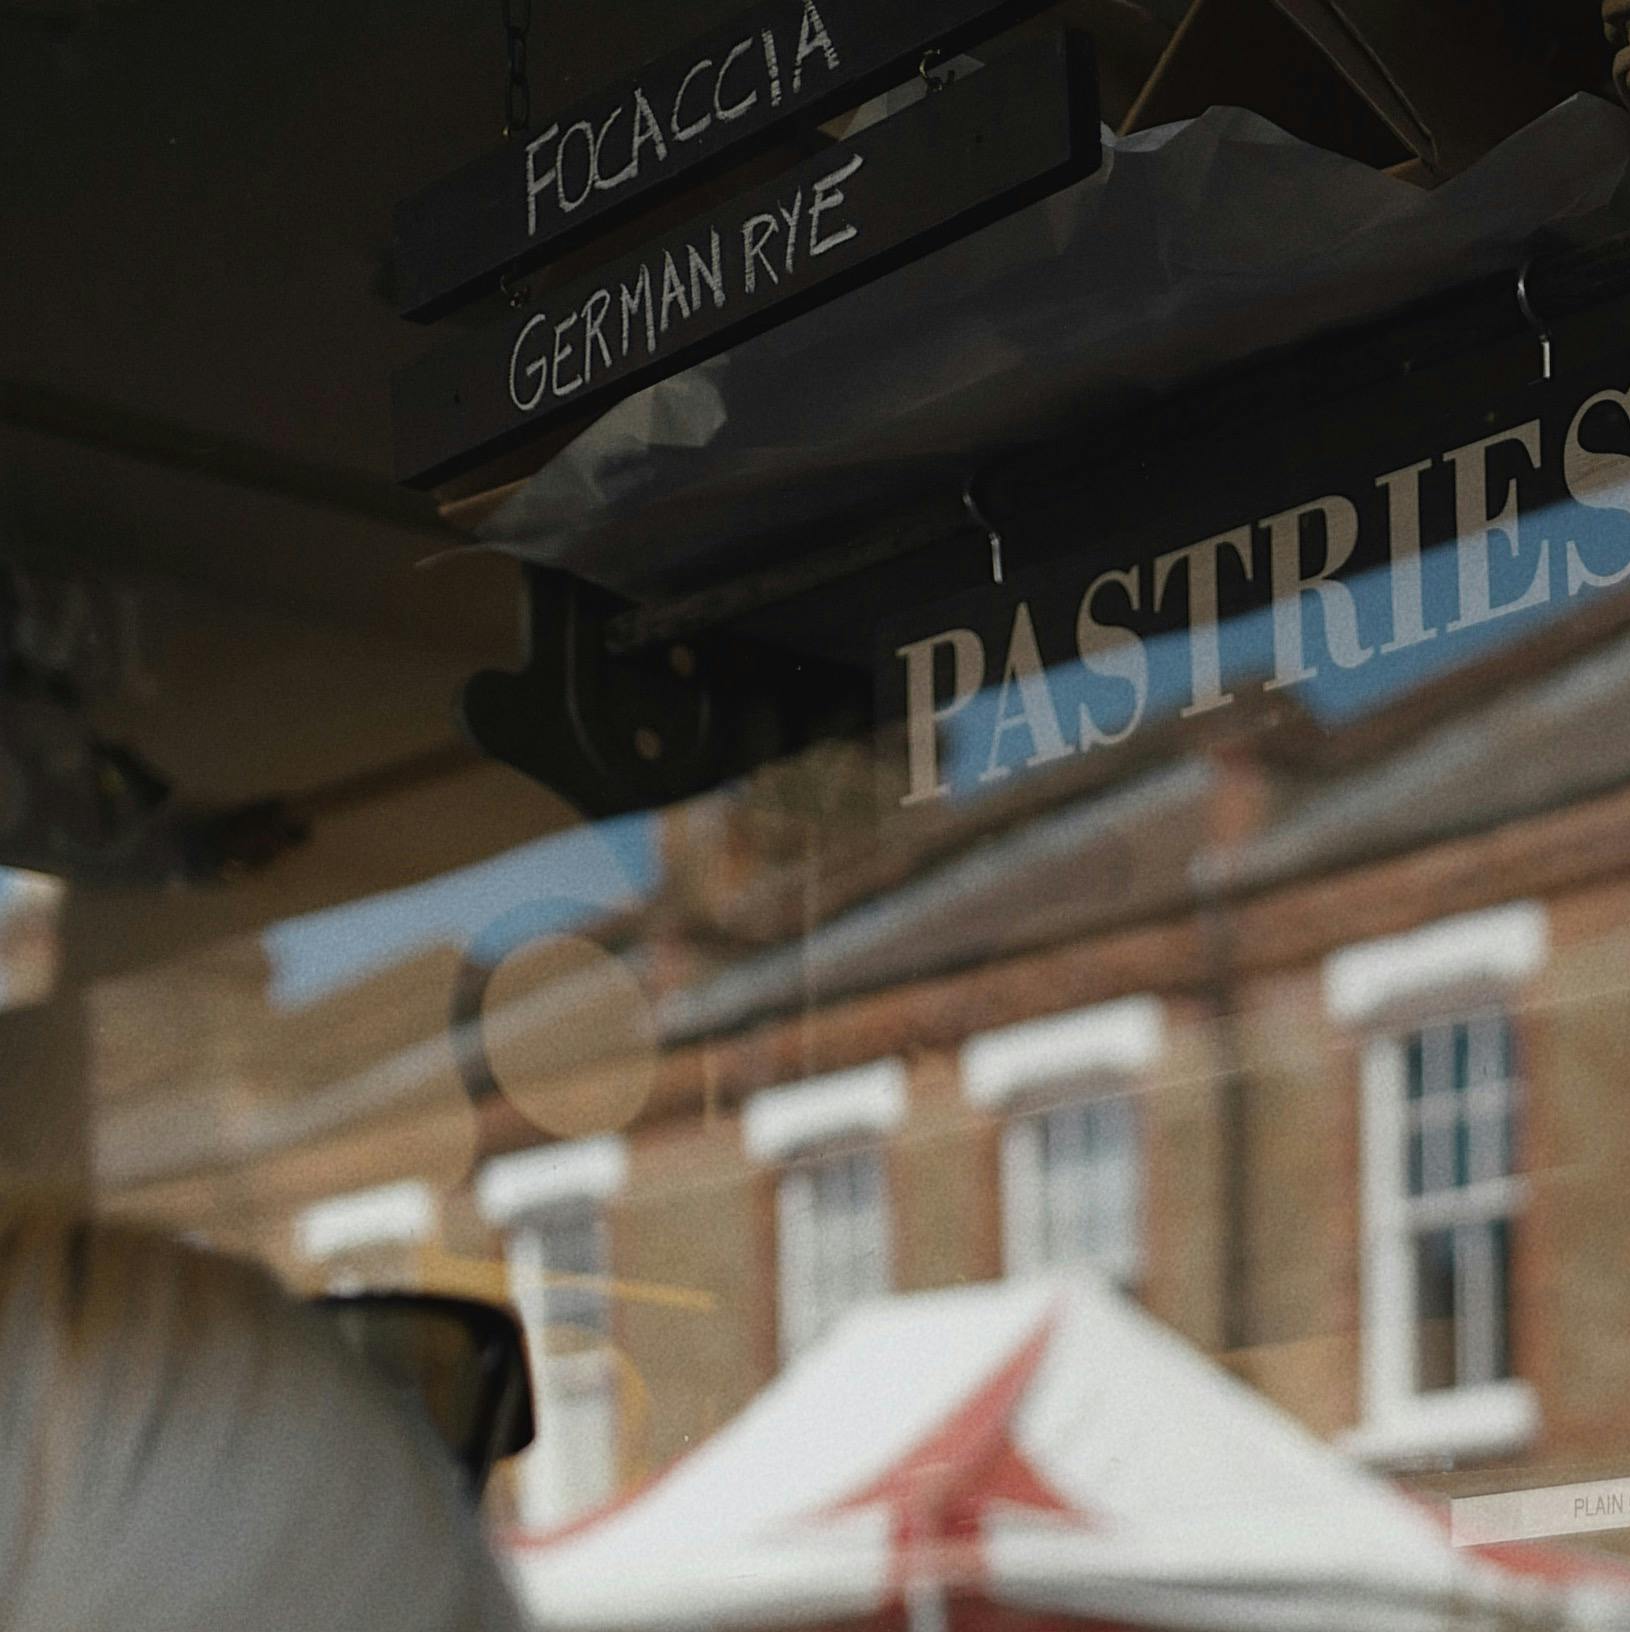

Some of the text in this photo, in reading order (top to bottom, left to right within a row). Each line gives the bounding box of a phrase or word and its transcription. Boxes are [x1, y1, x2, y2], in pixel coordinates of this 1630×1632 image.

[524, 0, 841, 237] FOCACCIA
[508, 153, 865, 413] GERMAN RYE
[1573, 1494, 1624, 1518] PLAIN
